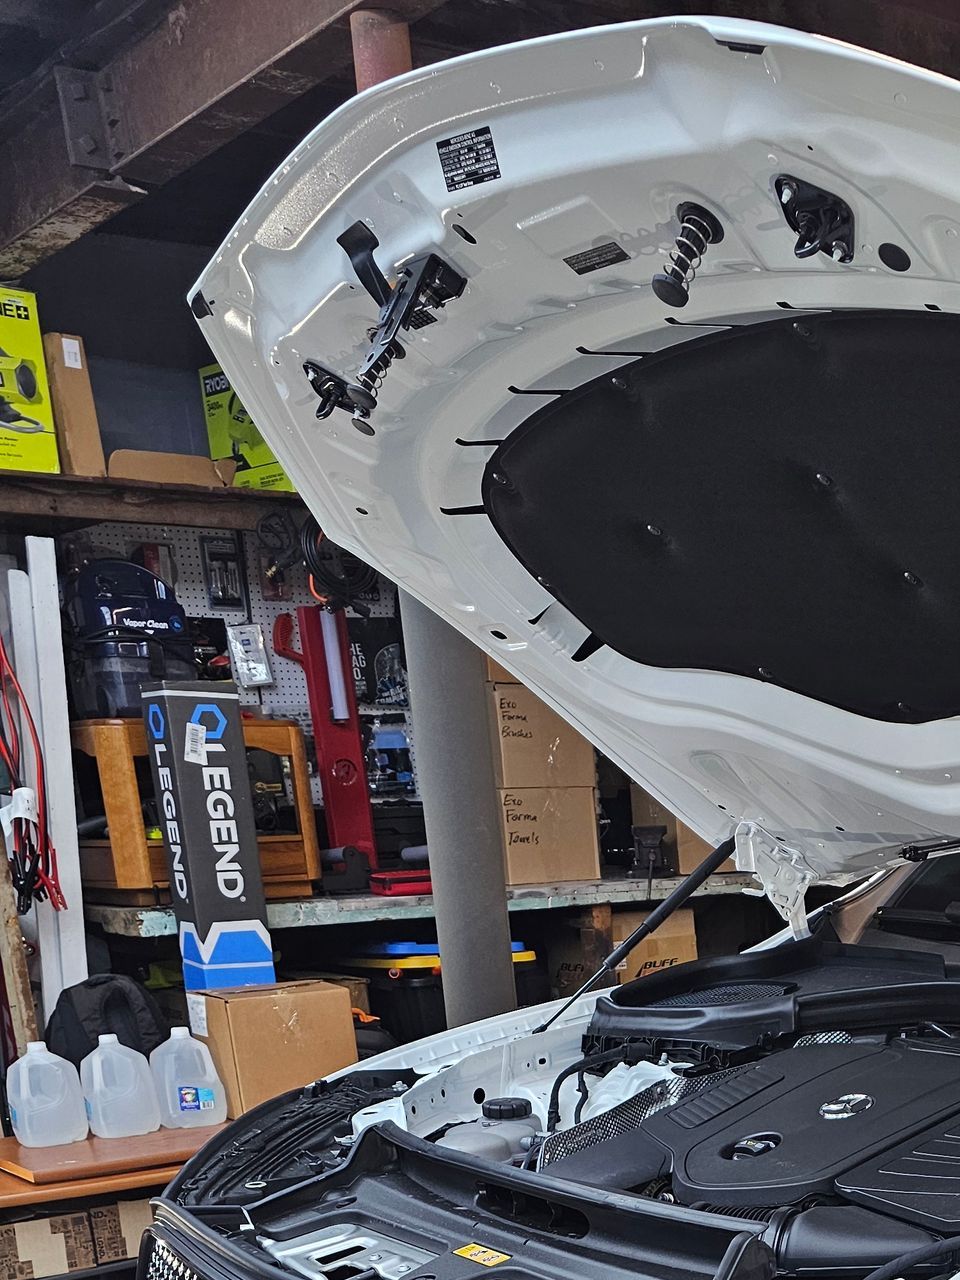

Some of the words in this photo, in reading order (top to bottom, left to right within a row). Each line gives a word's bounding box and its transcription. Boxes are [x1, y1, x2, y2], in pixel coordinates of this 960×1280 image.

[123, 618, 147, 628] Vapor
[147, 620, 169, 629] Clean
[500, 698, 517, 709] Exo
[502, 711, 528, 722] Forma
[501, 726, 532, 738] Brushes
[503, 794, 523, 806] Exo
[154, 743, 187, 900] LEGEND
[202, 743, 246, 900] LEGEND
[506, 809, 537, 823] Forma
[508, 832, 540, 847] Towels
[643, 957, 679, 969] BUFF
